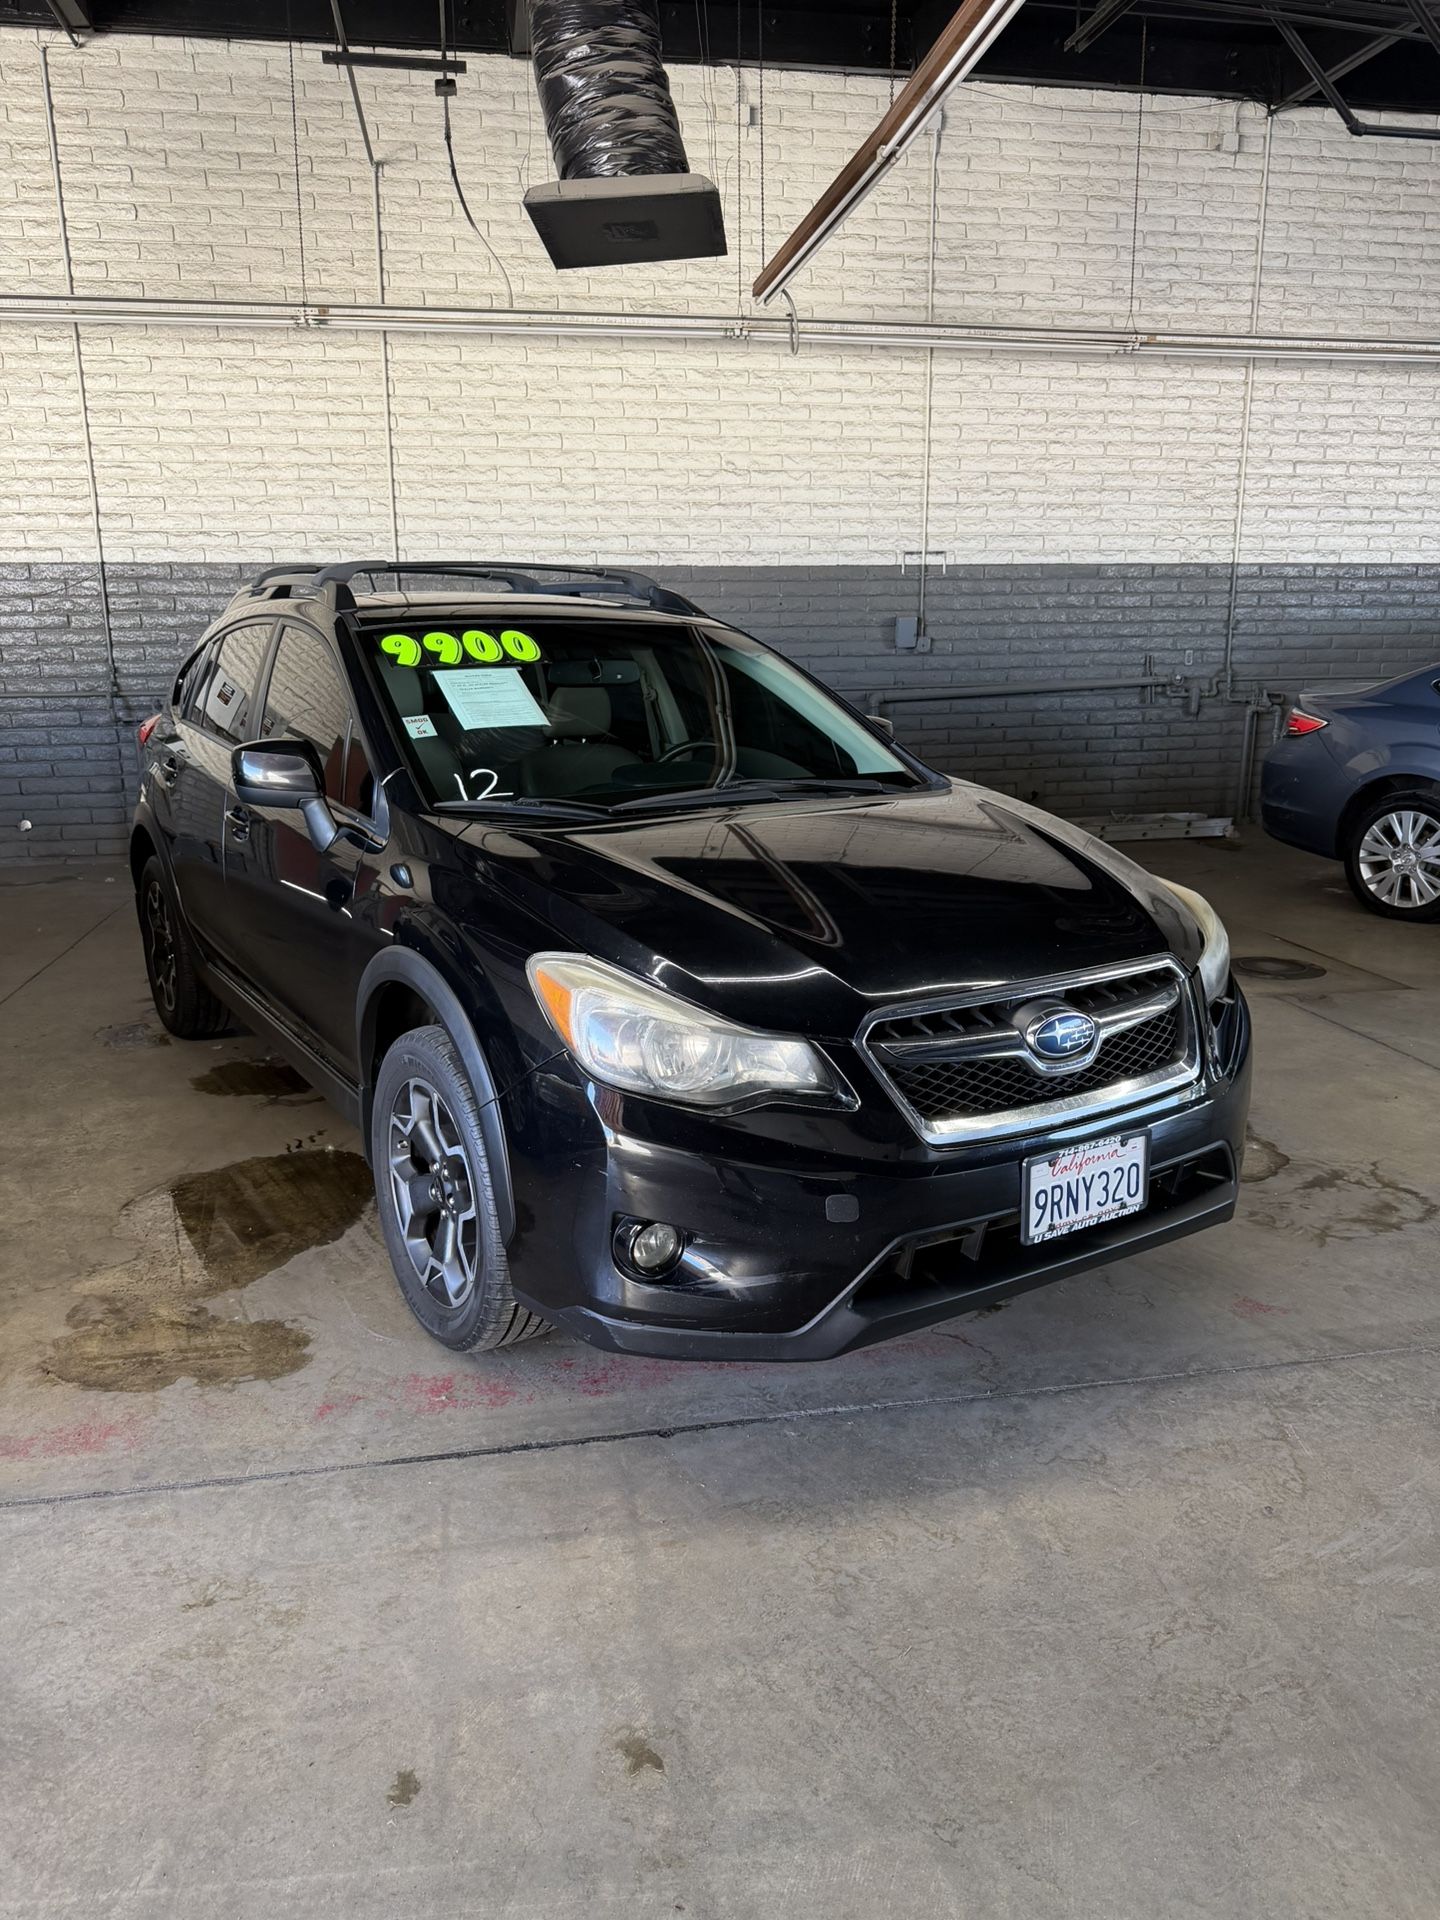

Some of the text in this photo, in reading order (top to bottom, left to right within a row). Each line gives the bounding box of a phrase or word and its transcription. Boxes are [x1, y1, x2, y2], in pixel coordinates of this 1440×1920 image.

[381, 630, 541, 667] 9900
[454, 769, 514, 801] 12
[1051, 1148, 1127, 1177] California
[1033, 1162, 1140, 1229] 9RNY320
[1043, 1226, 1070, 1240] SAVE
[1071, 1218, 1098, 1231] AUTO
[1099, 1204, 1140, 1222] AUCTION
